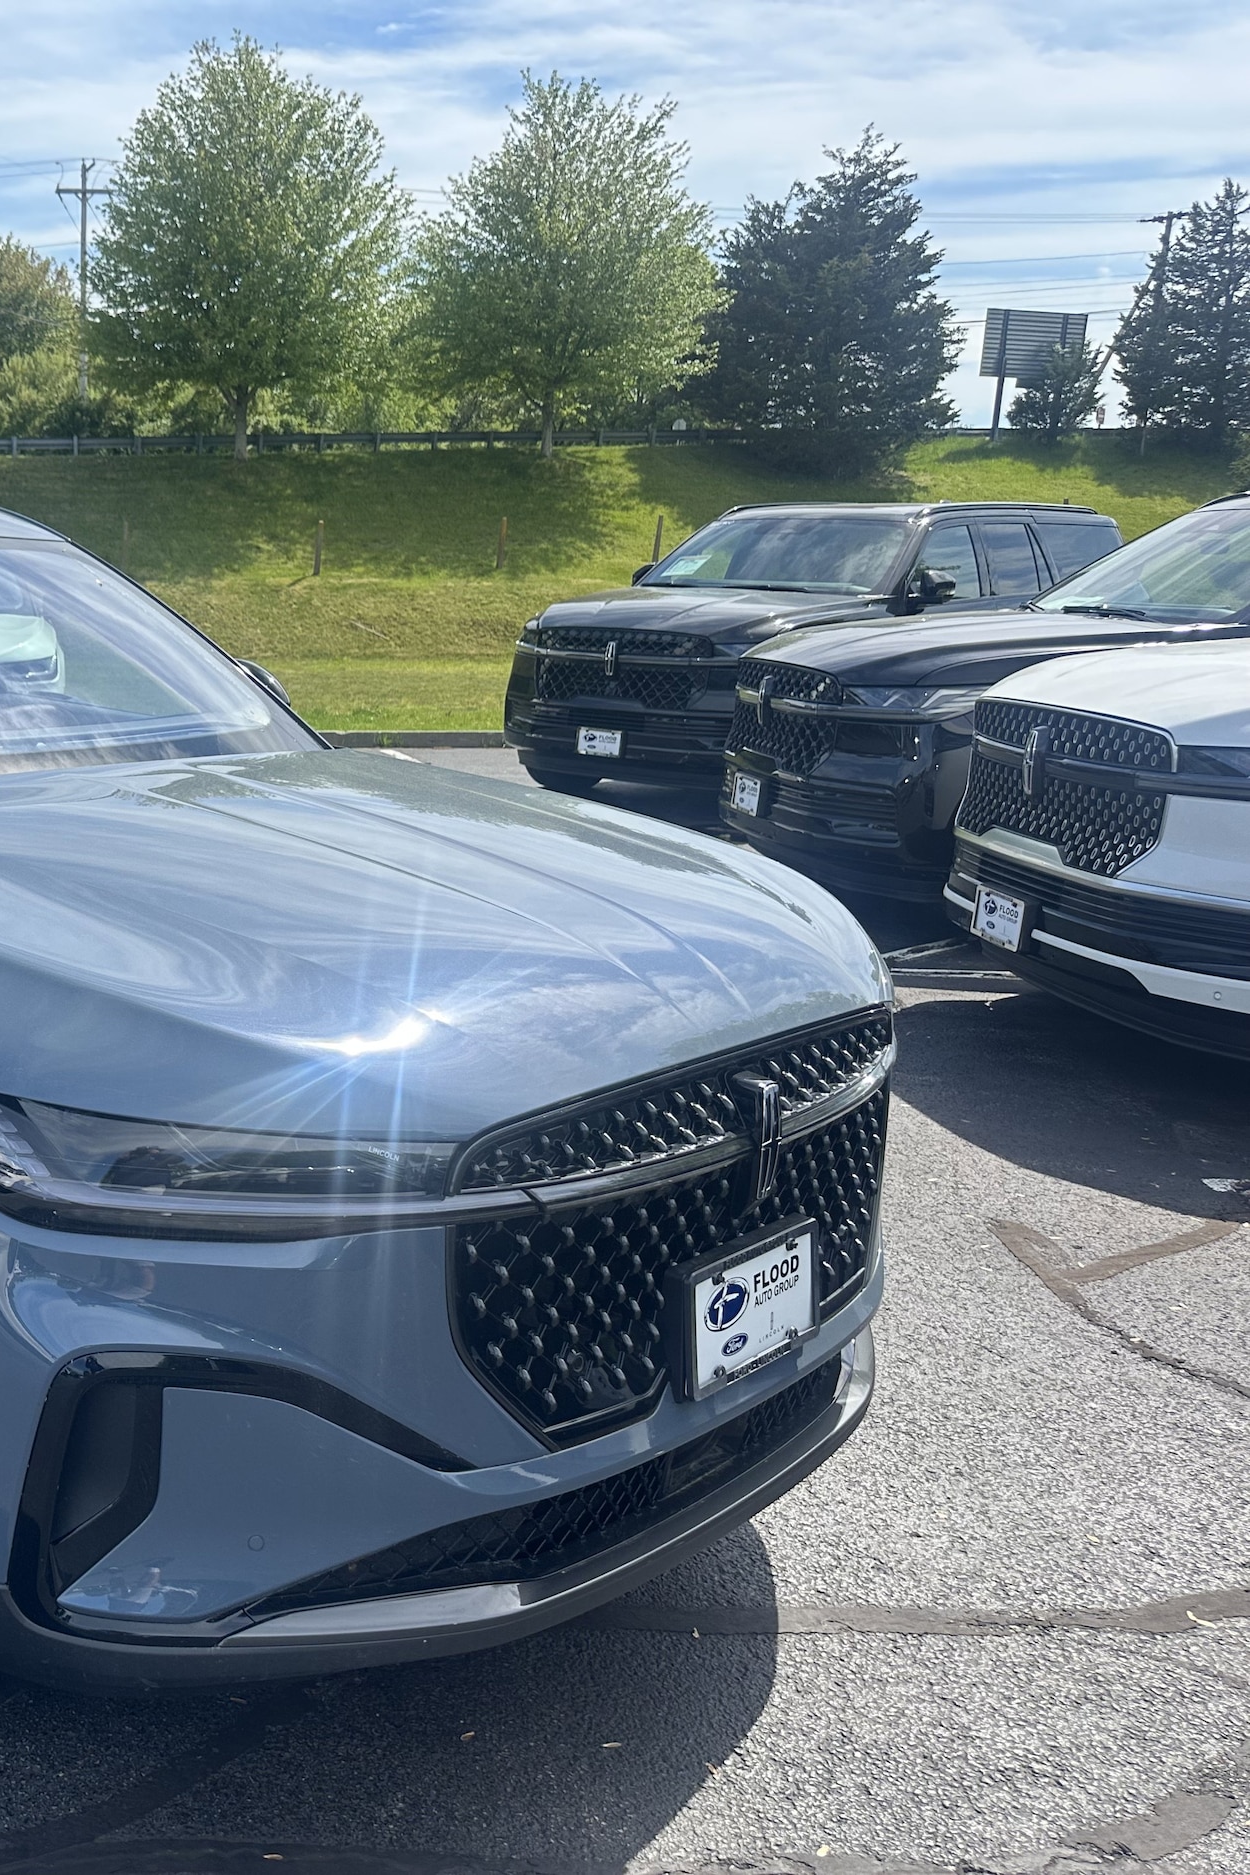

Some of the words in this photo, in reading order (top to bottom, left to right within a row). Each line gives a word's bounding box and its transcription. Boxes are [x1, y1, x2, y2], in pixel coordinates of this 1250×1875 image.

[999, 905, 1018, 918] FLOOD
[368, 1145, 400, 1162] LINCOLN
[754, 1254, 799, 1293] FLOOD
[754, 1288, 772, 1308] AUTO
[774, 1274, 799, 1297] GROUP
[758, 1324, 785, 1343] LINCOLN
[724, 1335, 746, 1354] Ford
